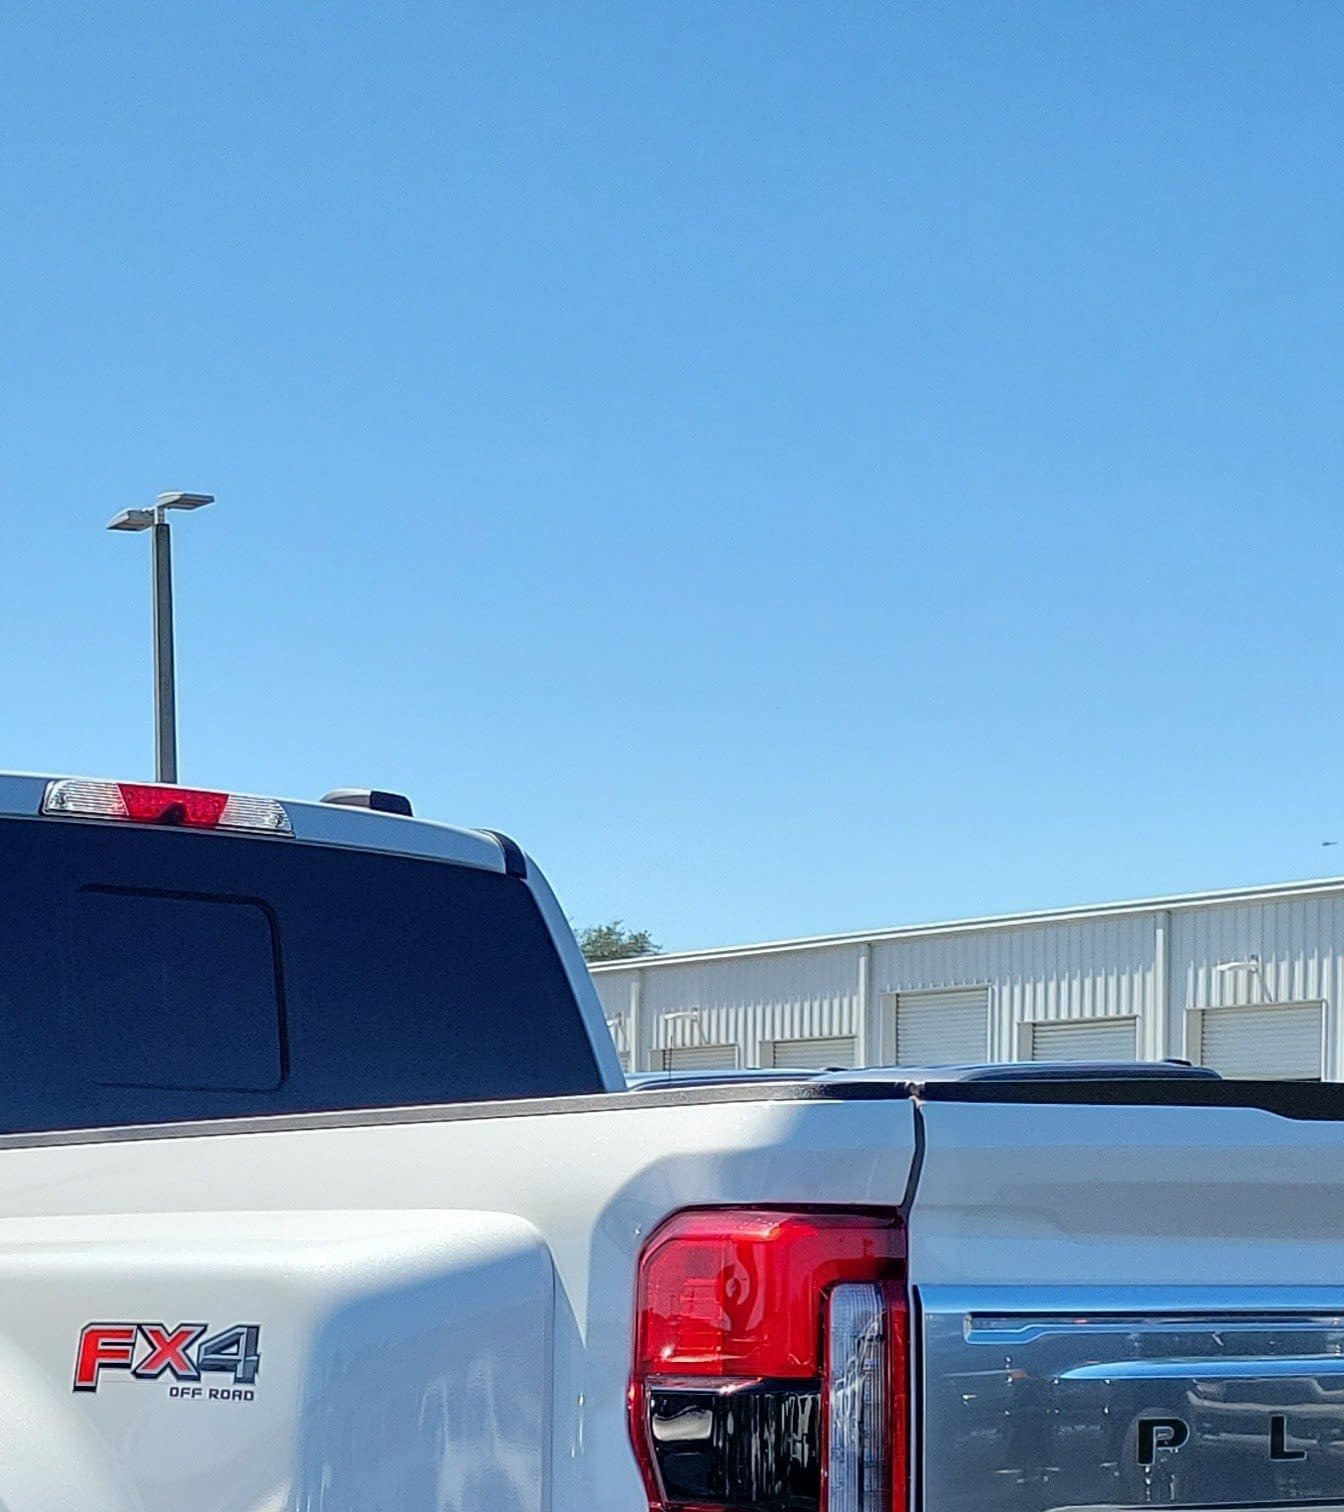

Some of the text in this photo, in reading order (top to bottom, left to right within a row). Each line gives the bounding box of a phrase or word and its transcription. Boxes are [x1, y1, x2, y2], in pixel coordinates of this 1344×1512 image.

[72, 1321, 262, 1394] FX4
[168, 1385, 255, 1402] OFF ROAD
